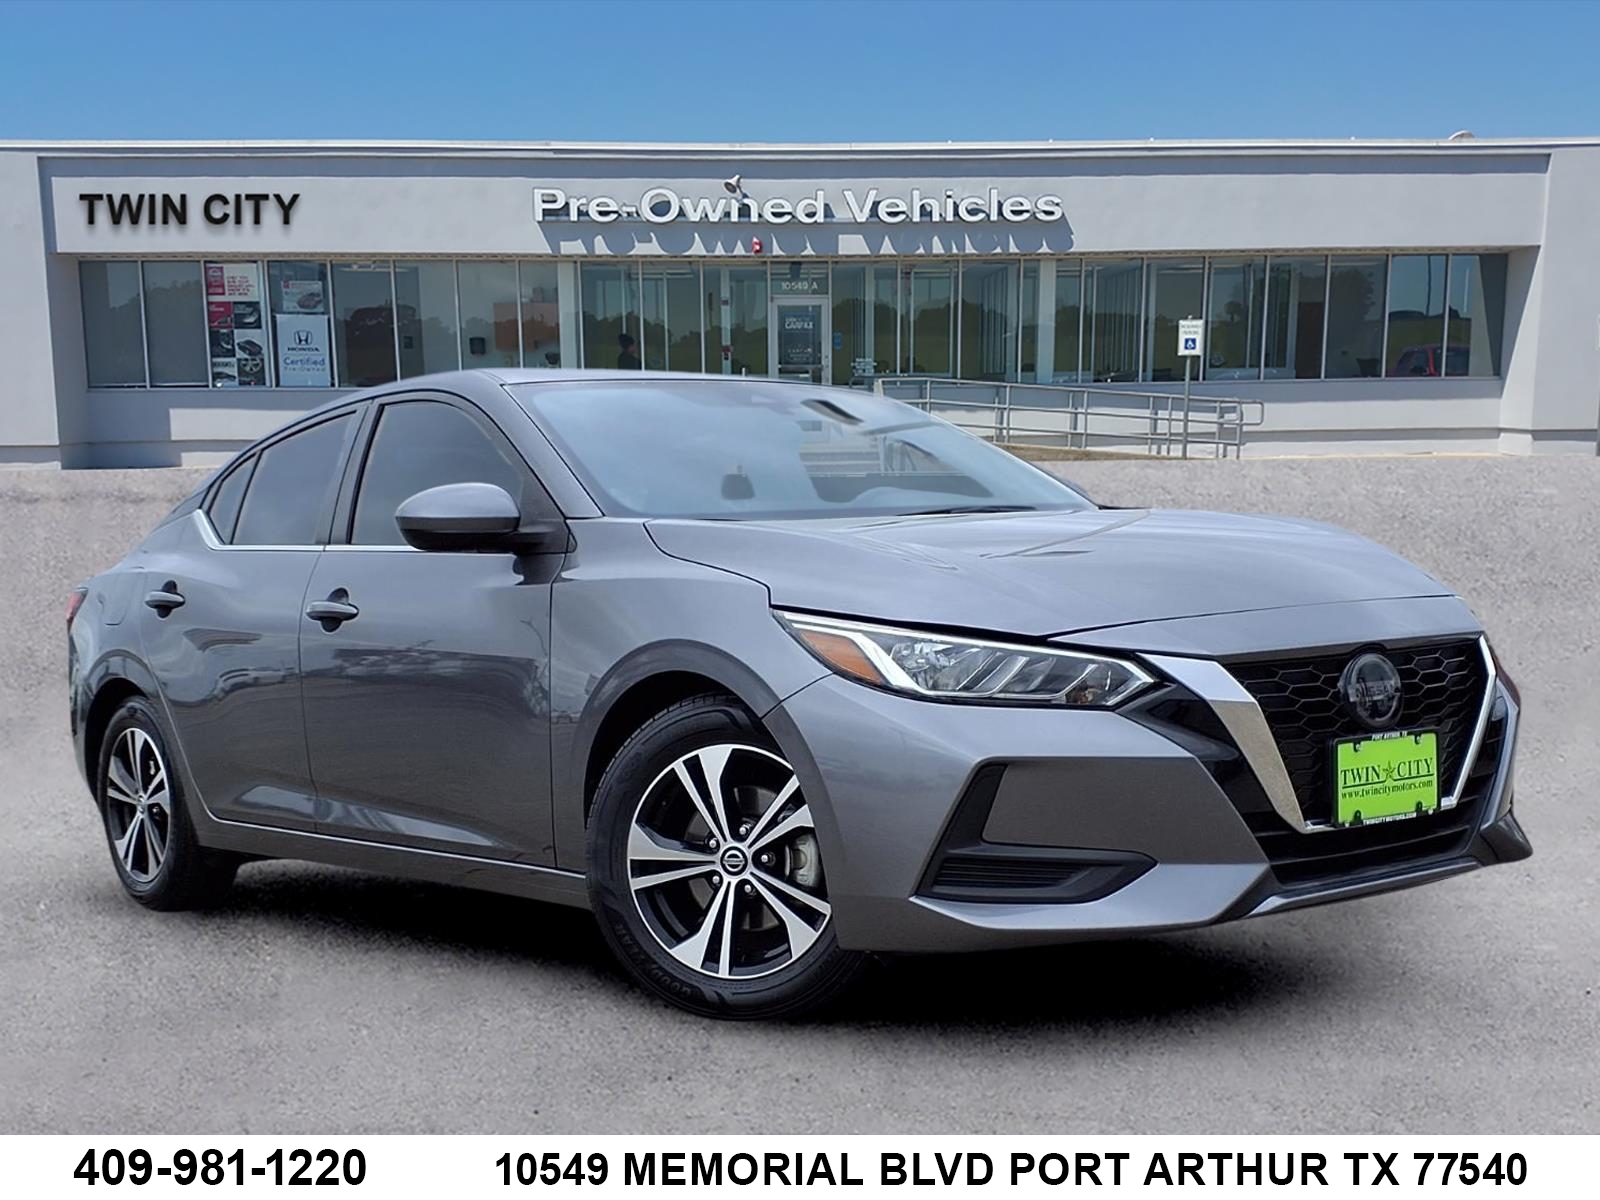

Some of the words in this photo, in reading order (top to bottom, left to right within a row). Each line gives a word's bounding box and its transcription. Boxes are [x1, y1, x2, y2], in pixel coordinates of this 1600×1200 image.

[80, 194, 187, 226] TWIN
[204, 194, 300, 226] CITY
[532, 186, 825, 224] Pre-Owned
[843, 187, 1064, 223] Vehicles
[781, 281, 809, 290] 10549
[811, 281, 819, 290] A
[283, 356, 325, 366] Certified
[1340, 764, 1381, 786] TWIN
[1397, 757, 1434, 778] CITY
[1341, 779, 1433, 799] www.twincitymotors.com
